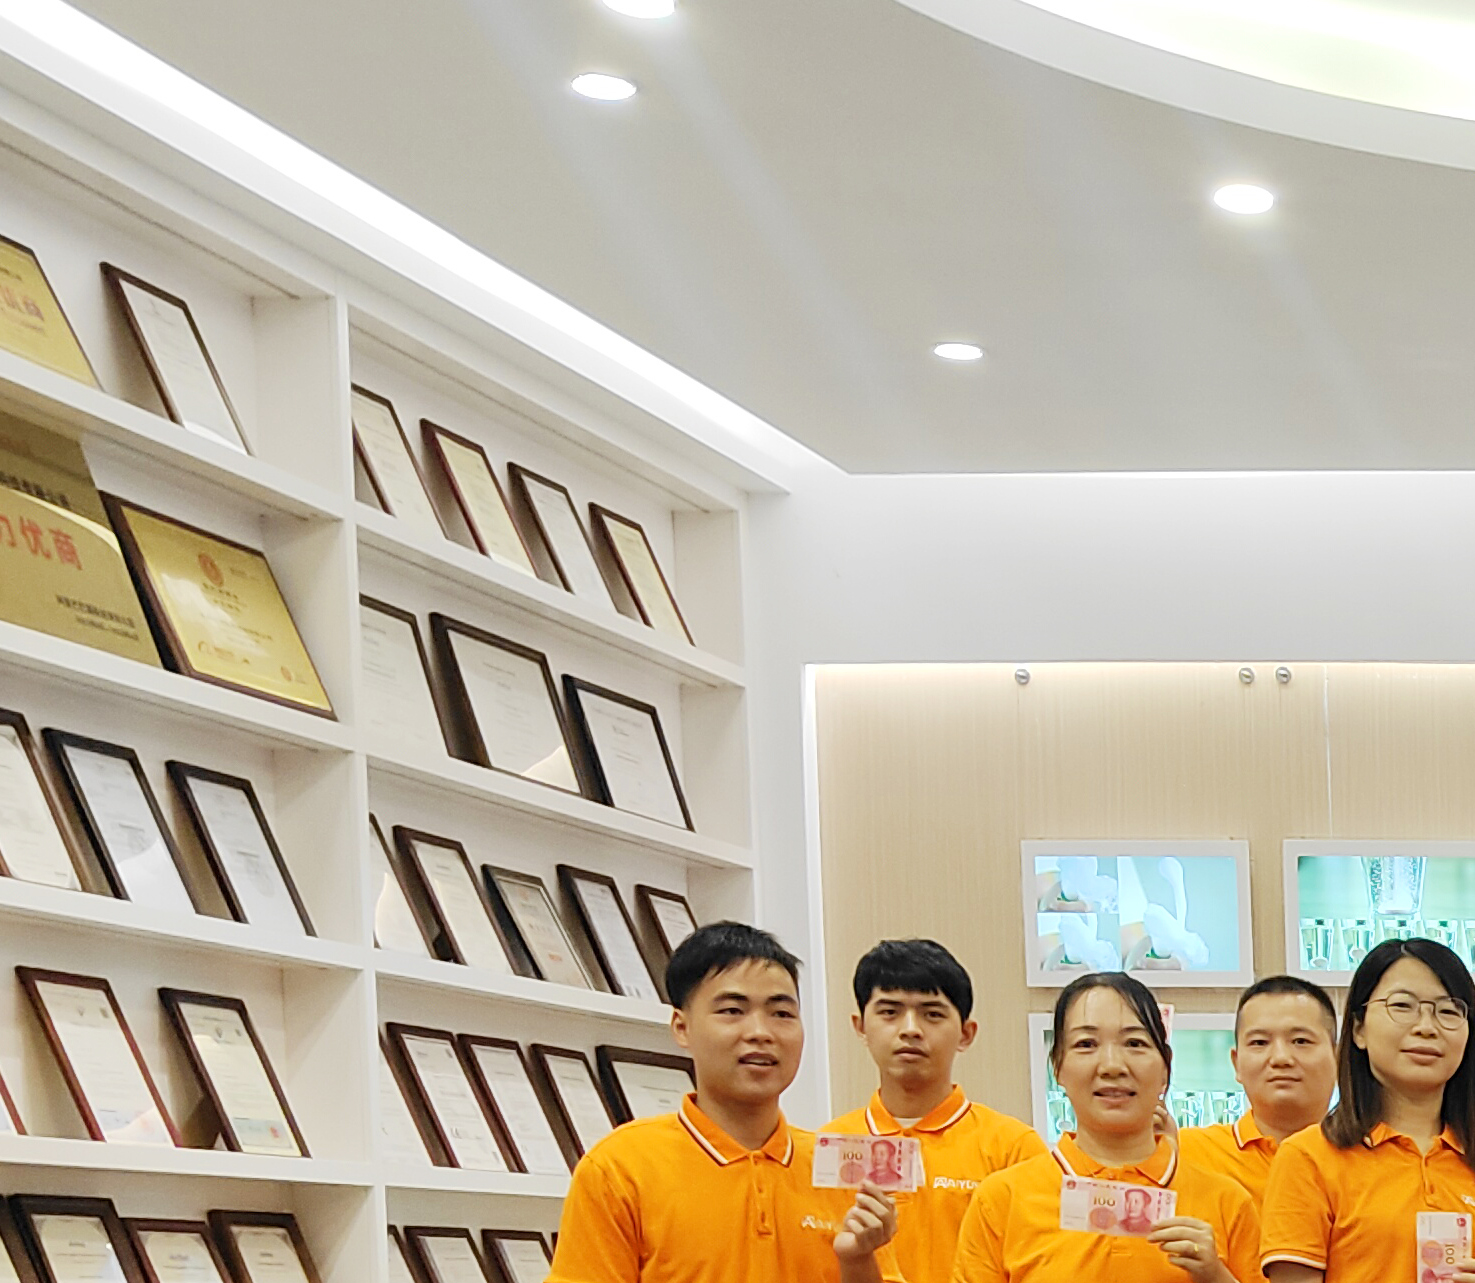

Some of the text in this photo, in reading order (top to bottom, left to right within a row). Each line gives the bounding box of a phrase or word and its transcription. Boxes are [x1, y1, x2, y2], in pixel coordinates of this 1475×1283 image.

[842, 1151, 863, 1161] 100
[1093, 1196, 1115, 1206] 100
[1445, 1244, 1454, 1265] 100
